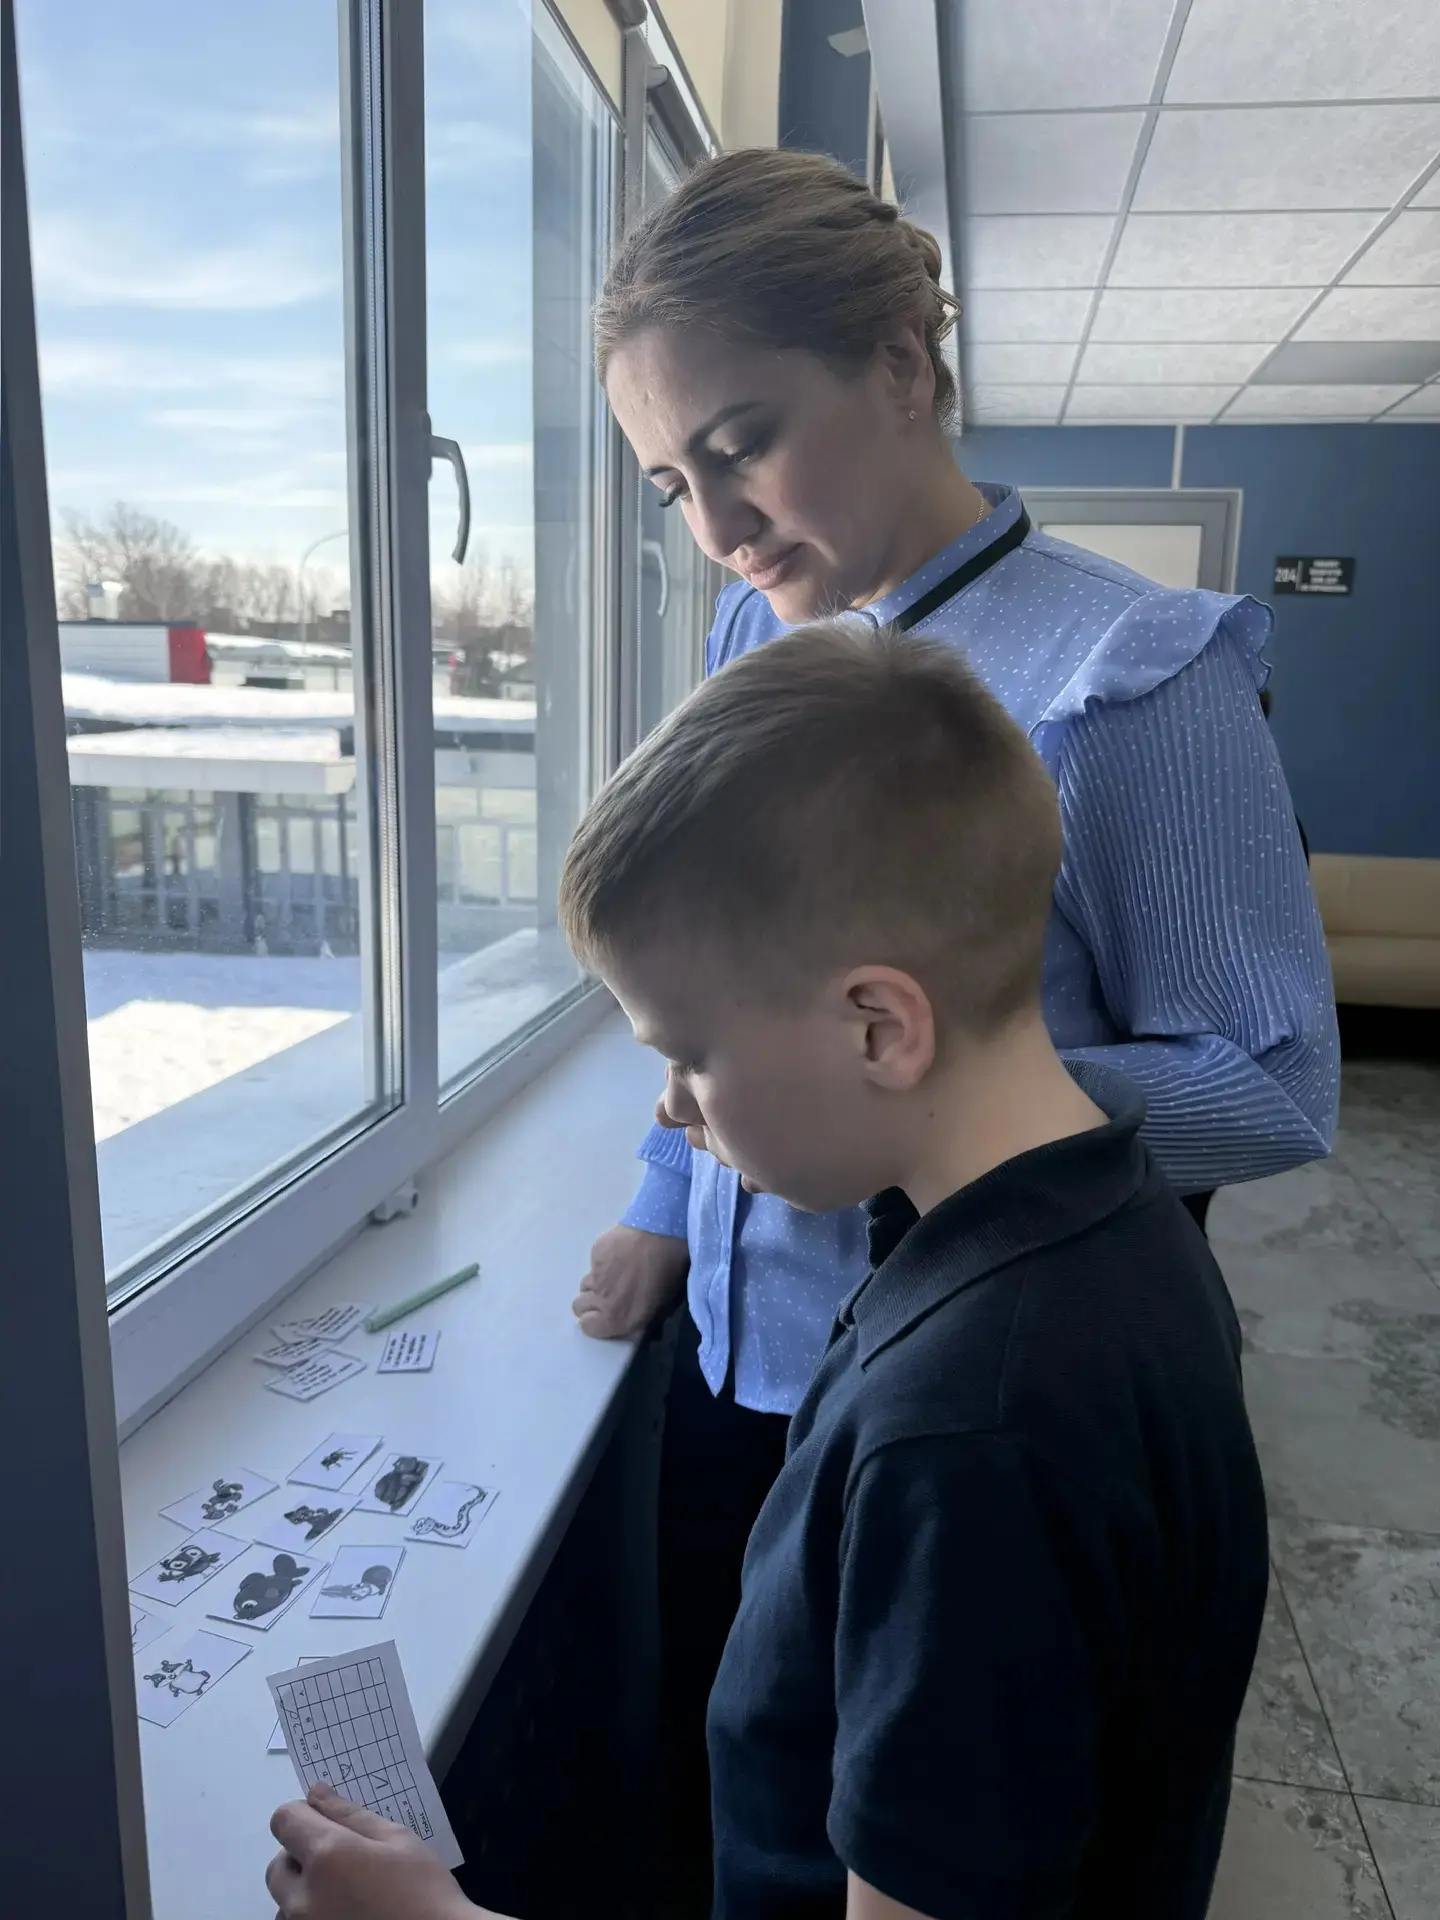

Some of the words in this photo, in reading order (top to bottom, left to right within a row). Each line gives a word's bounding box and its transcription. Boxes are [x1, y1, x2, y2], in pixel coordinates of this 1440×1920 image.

[1274, 567, 1297, 583] 204
[300, 1738, 309, 1761] Class
[420, 1812, 430, 1834] Total
